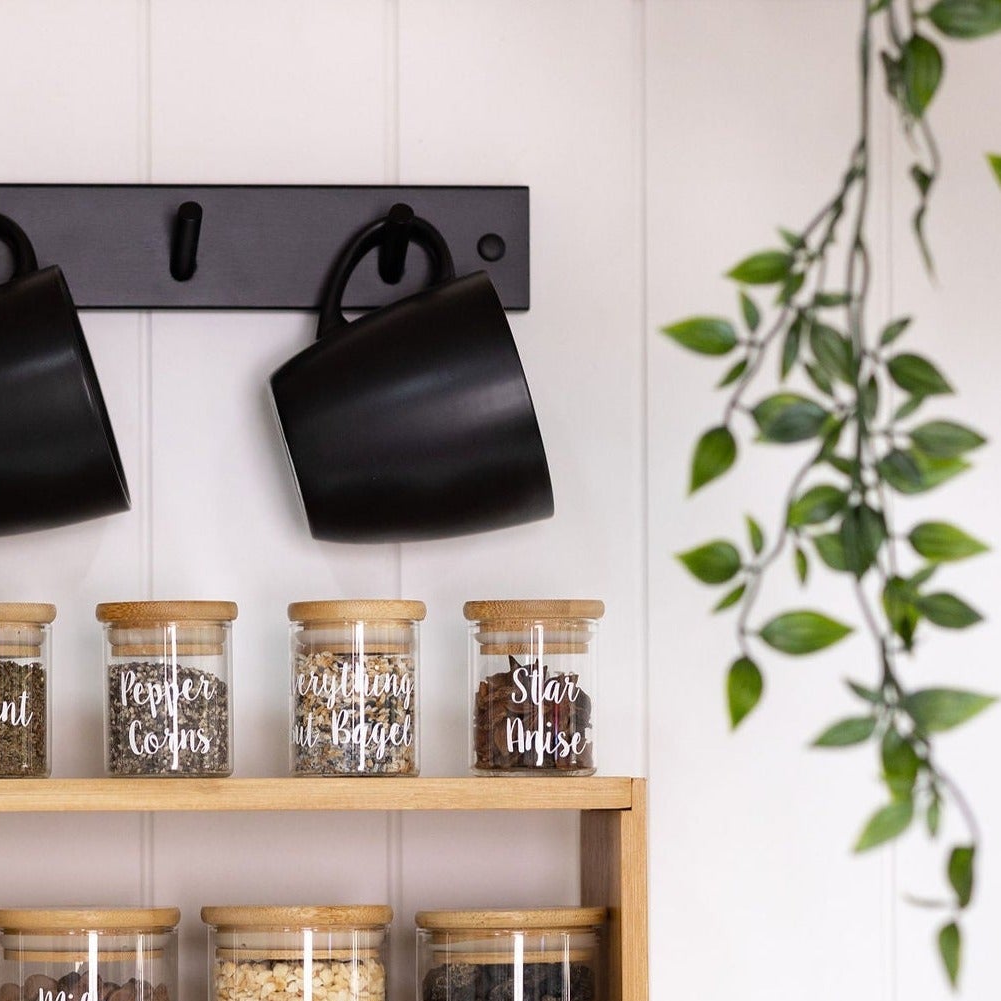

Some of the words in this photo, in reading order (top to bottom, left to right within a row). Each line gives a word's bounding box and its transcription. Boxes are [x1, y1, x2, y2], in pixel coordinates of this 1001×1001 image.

[120, 670, 215, 718] Pepper
[511, 667, 580, 705] Star
[128, 720, 212, 755] Corns
[332, 709, 413, 760] Bagel
[506, 717, 587, 758] Anise
